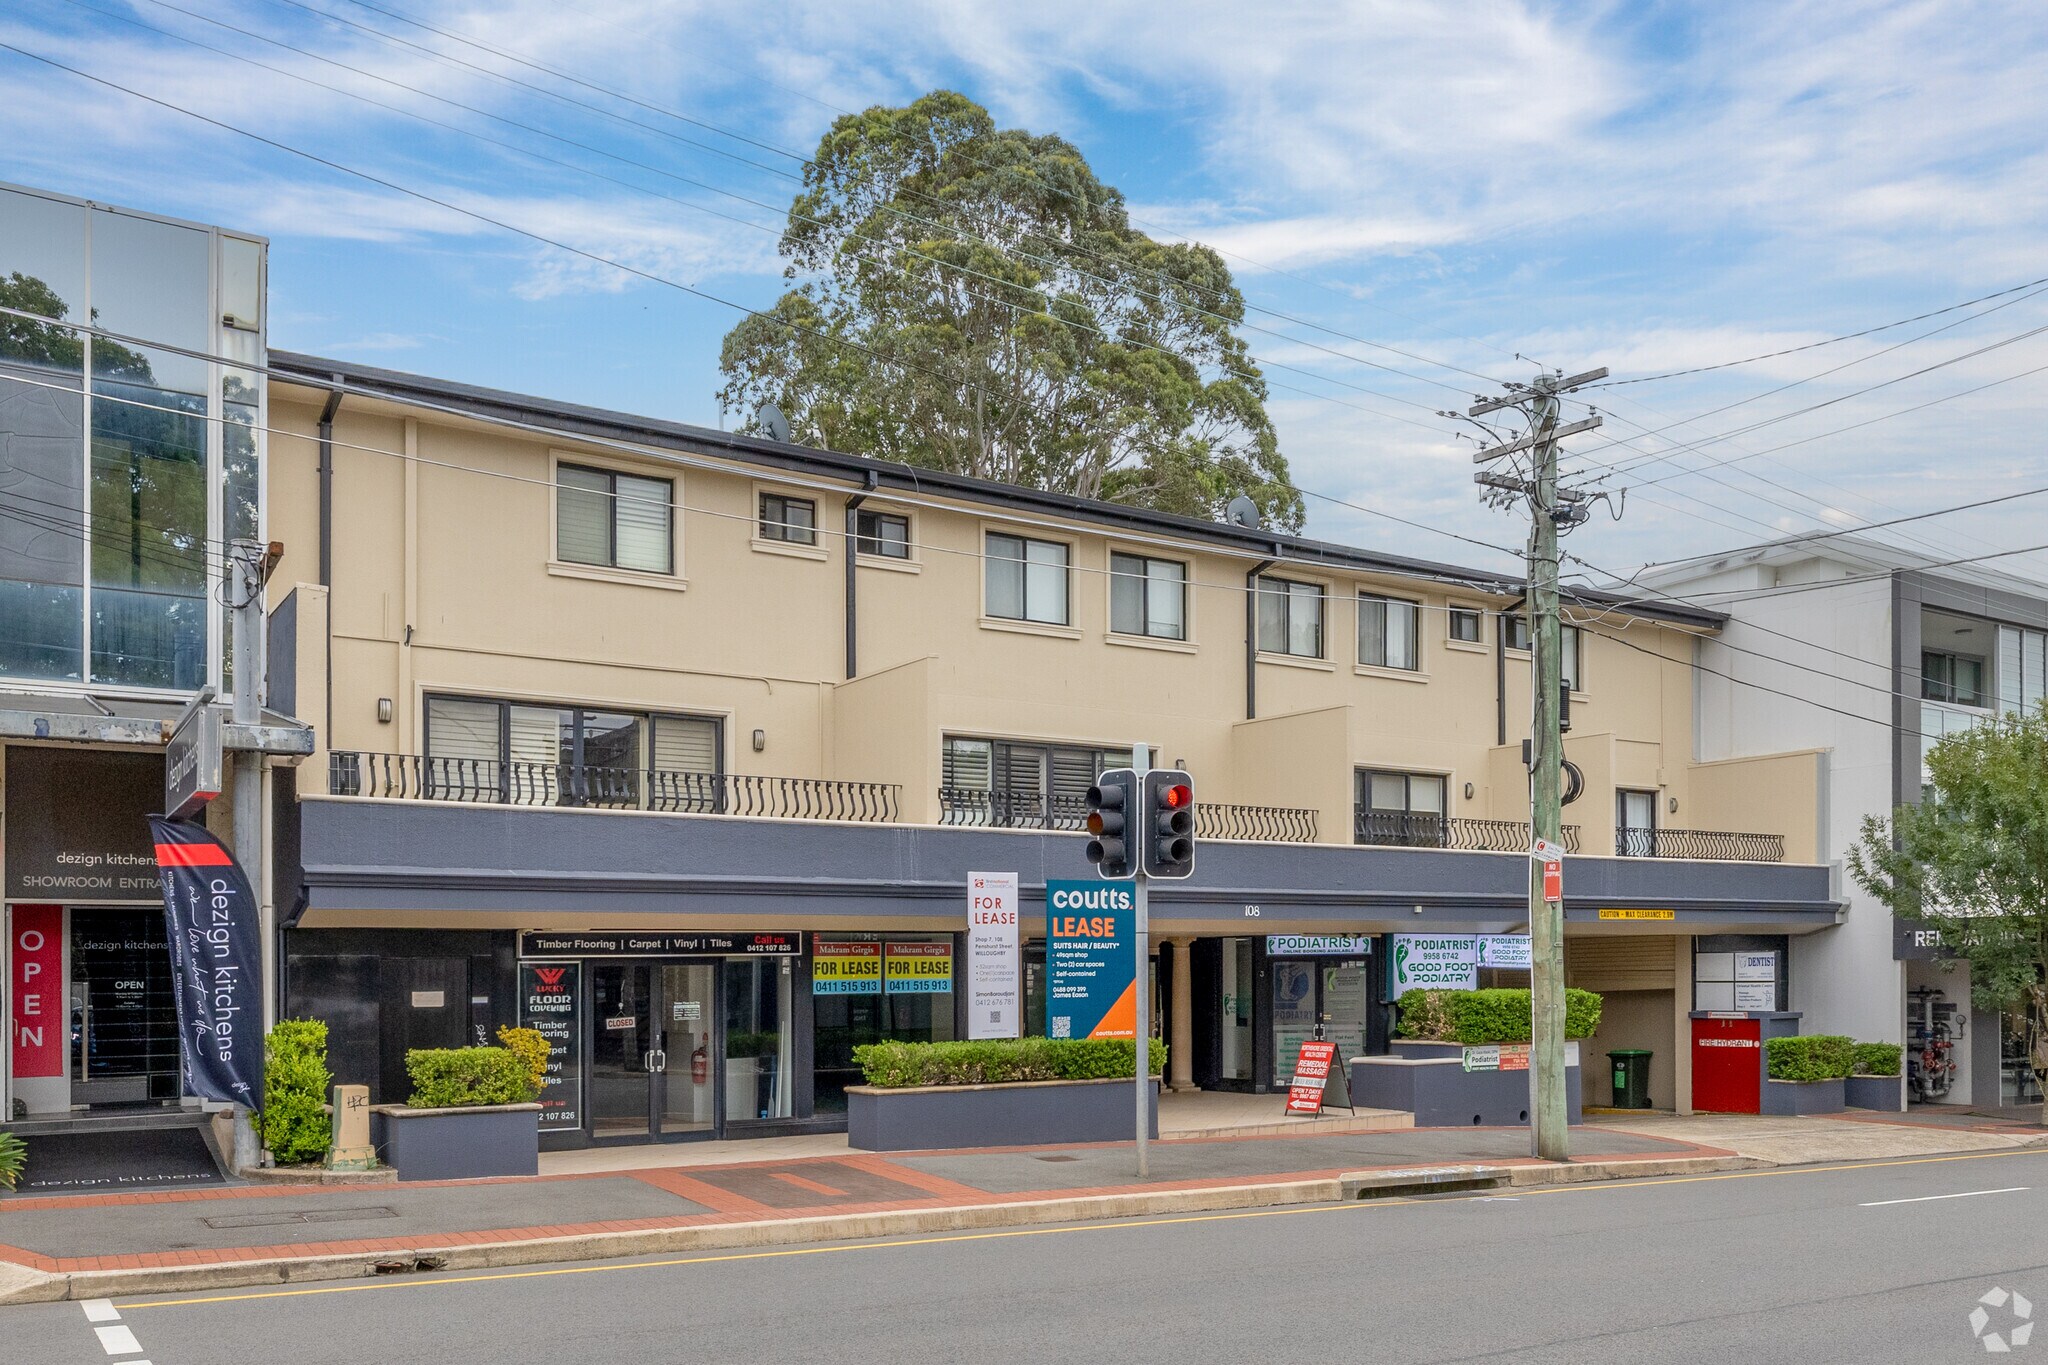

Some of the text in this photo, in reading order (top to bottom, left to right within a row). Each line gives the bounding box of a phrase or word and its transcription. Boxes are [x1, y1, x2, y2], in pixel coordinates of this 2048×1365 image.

[56, 852, 160, 867] dezign kitchens
[22, 875, 163, 889] SHOWROOM ENTRA
[974, 897, 1002, 909] FOR
[1245, 905, 1260, 917] 108
[1600, 910, 1620, 918] CAUTION
[1625, 910, 1635, 918] MAX
[206, 878, 237, 958] dezign
[974, 912, 1016, 925] LEASE
[1052, 917, 1115, 938] LEASE
[754, 935, 772, 944] Call
[1277, 937, 1360, 949] PODIATRIST
[83, 940, 168, 951] dezign kitchens
[536, 939, 732, 951] Timber Flooring Carpet Vinyl Tiles
[819, 945, 874, 955] Makram Girgis
[893, 945, 945, 955] Makram Girgis
[1414, 940, 1476, 950] PODIATRIST
[1423, 952, 1459, 960] 9958 6742
[1408, 962, 1475, 972] GOOD FOOT
[1747, 957, 1775, 967] DENTIST
[814, 961, 879, 975] FOR LEASE
[888, 961, 949, 975] FOR LEASE
[1413, 973, 1471, 983] PODIATRY
[115, 981, 144, 989] OPEN
[536, 985, 565, 993] LUCKY
[815, 981, 877, 992] 0411 515 913
[889, 980, 948, 991] 0411 515 913
[529, 995, 572, 1004] FLOOR
[529, 1004, 572, 1012] COVERING
[214, 966, 240, 1062] kitchens
[533, 1021, 567, 1029] Timber
[607, 1018, 634, 1028] CLOSED
[540, 1029, 569, 1039] ooring
[1298, 1060, 1328, 1068] REMEDIAL
[1296, 1067, 1327, 1076] MASSAGE
[30, 1173, 211, 1187] dezign kitchens
